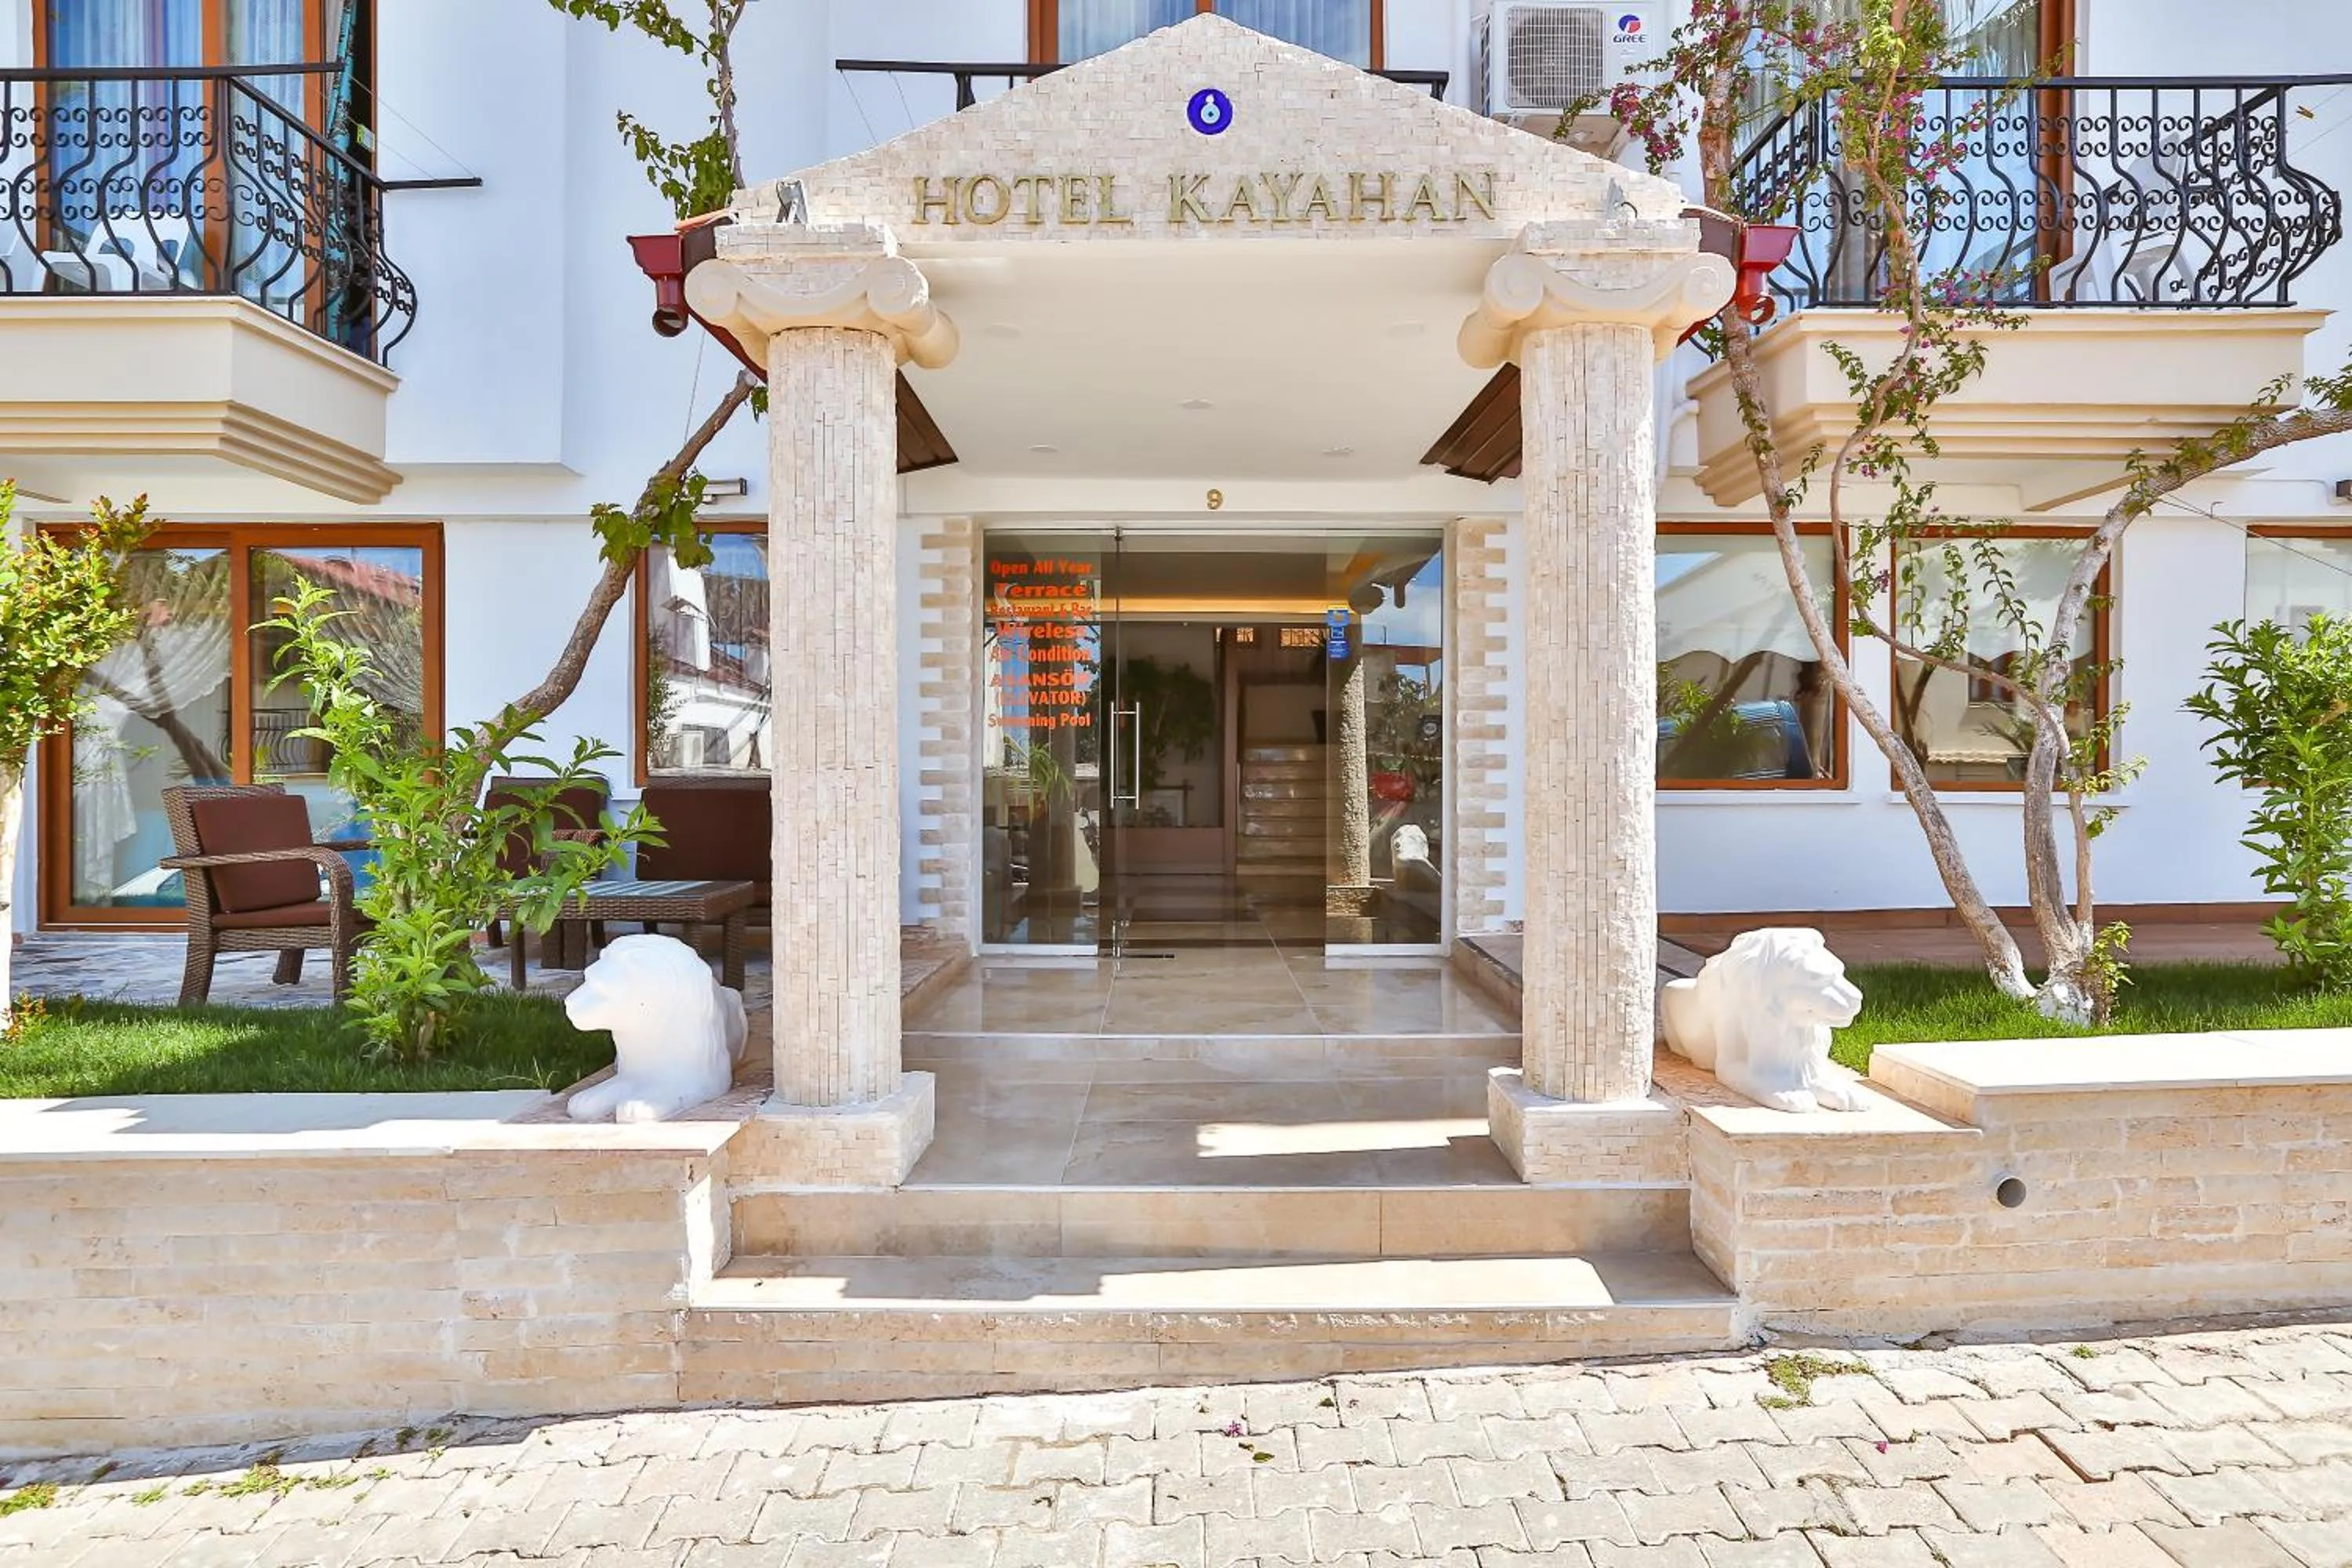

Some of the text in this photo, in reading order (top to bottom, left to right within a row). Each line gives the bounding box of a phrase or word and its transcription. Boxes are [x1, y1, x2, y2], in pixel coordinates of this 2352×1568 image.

[1613, 34, 1647, 43] GREE
[912, 171, 1495, 225] HOTEL KAYAHAN
[1207, 488, 1223, 510] 9
[989, 559, 1091, 575] Open All Year
[994, 583, 1087, 597] Terrace
[1071, 601, 1092, 617] Bar
[996, 621, 1087, 638] Wireless
[1017, 644, 1091, 662] Condition
[1060, 712, 1091, 727] Pool
